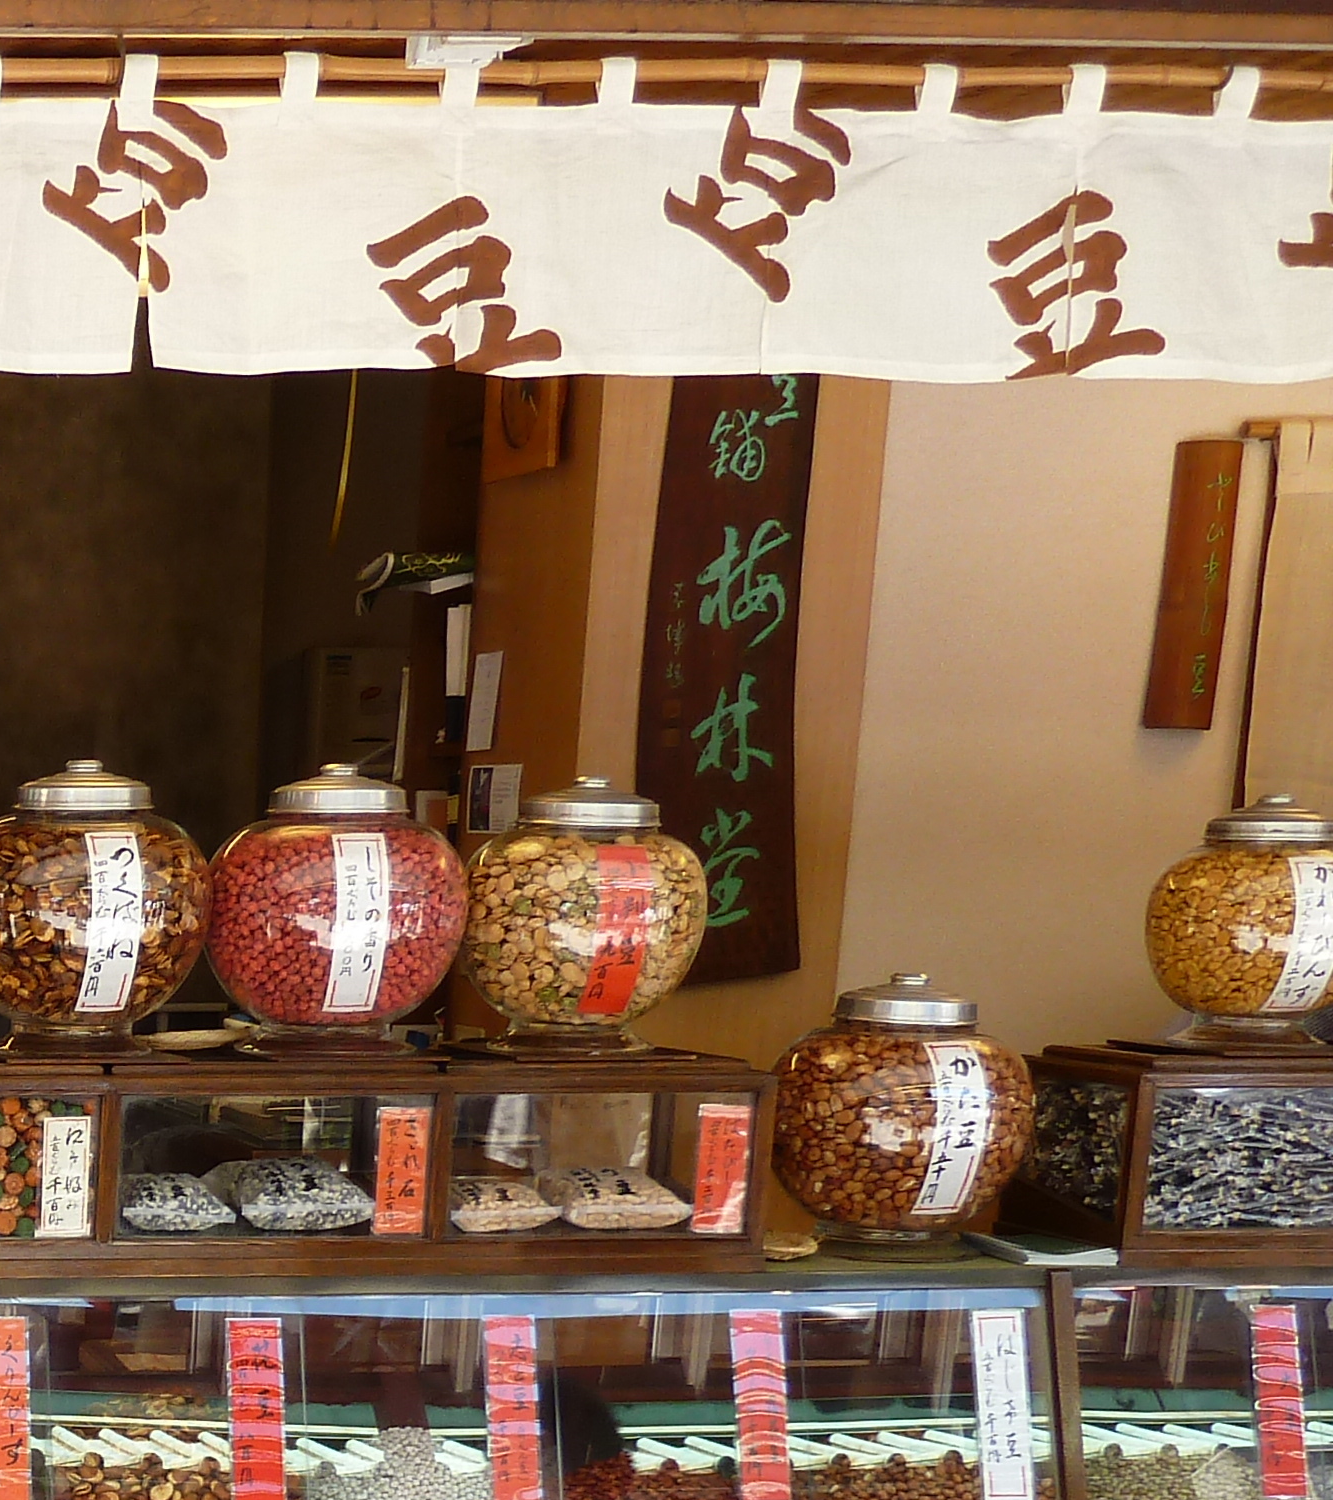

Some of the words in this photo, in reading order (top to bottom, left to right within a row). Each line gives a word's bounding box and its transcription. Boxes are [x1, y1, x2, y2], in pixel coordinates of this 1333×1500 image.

[43, 100, 227, 293] 豆
[366, 195, 561, 371] 豆
[664, 106, 850, 302] 豆
[988, 189, 1166, 381] 豆
[690, 519, 791, 927] 梅林堂
